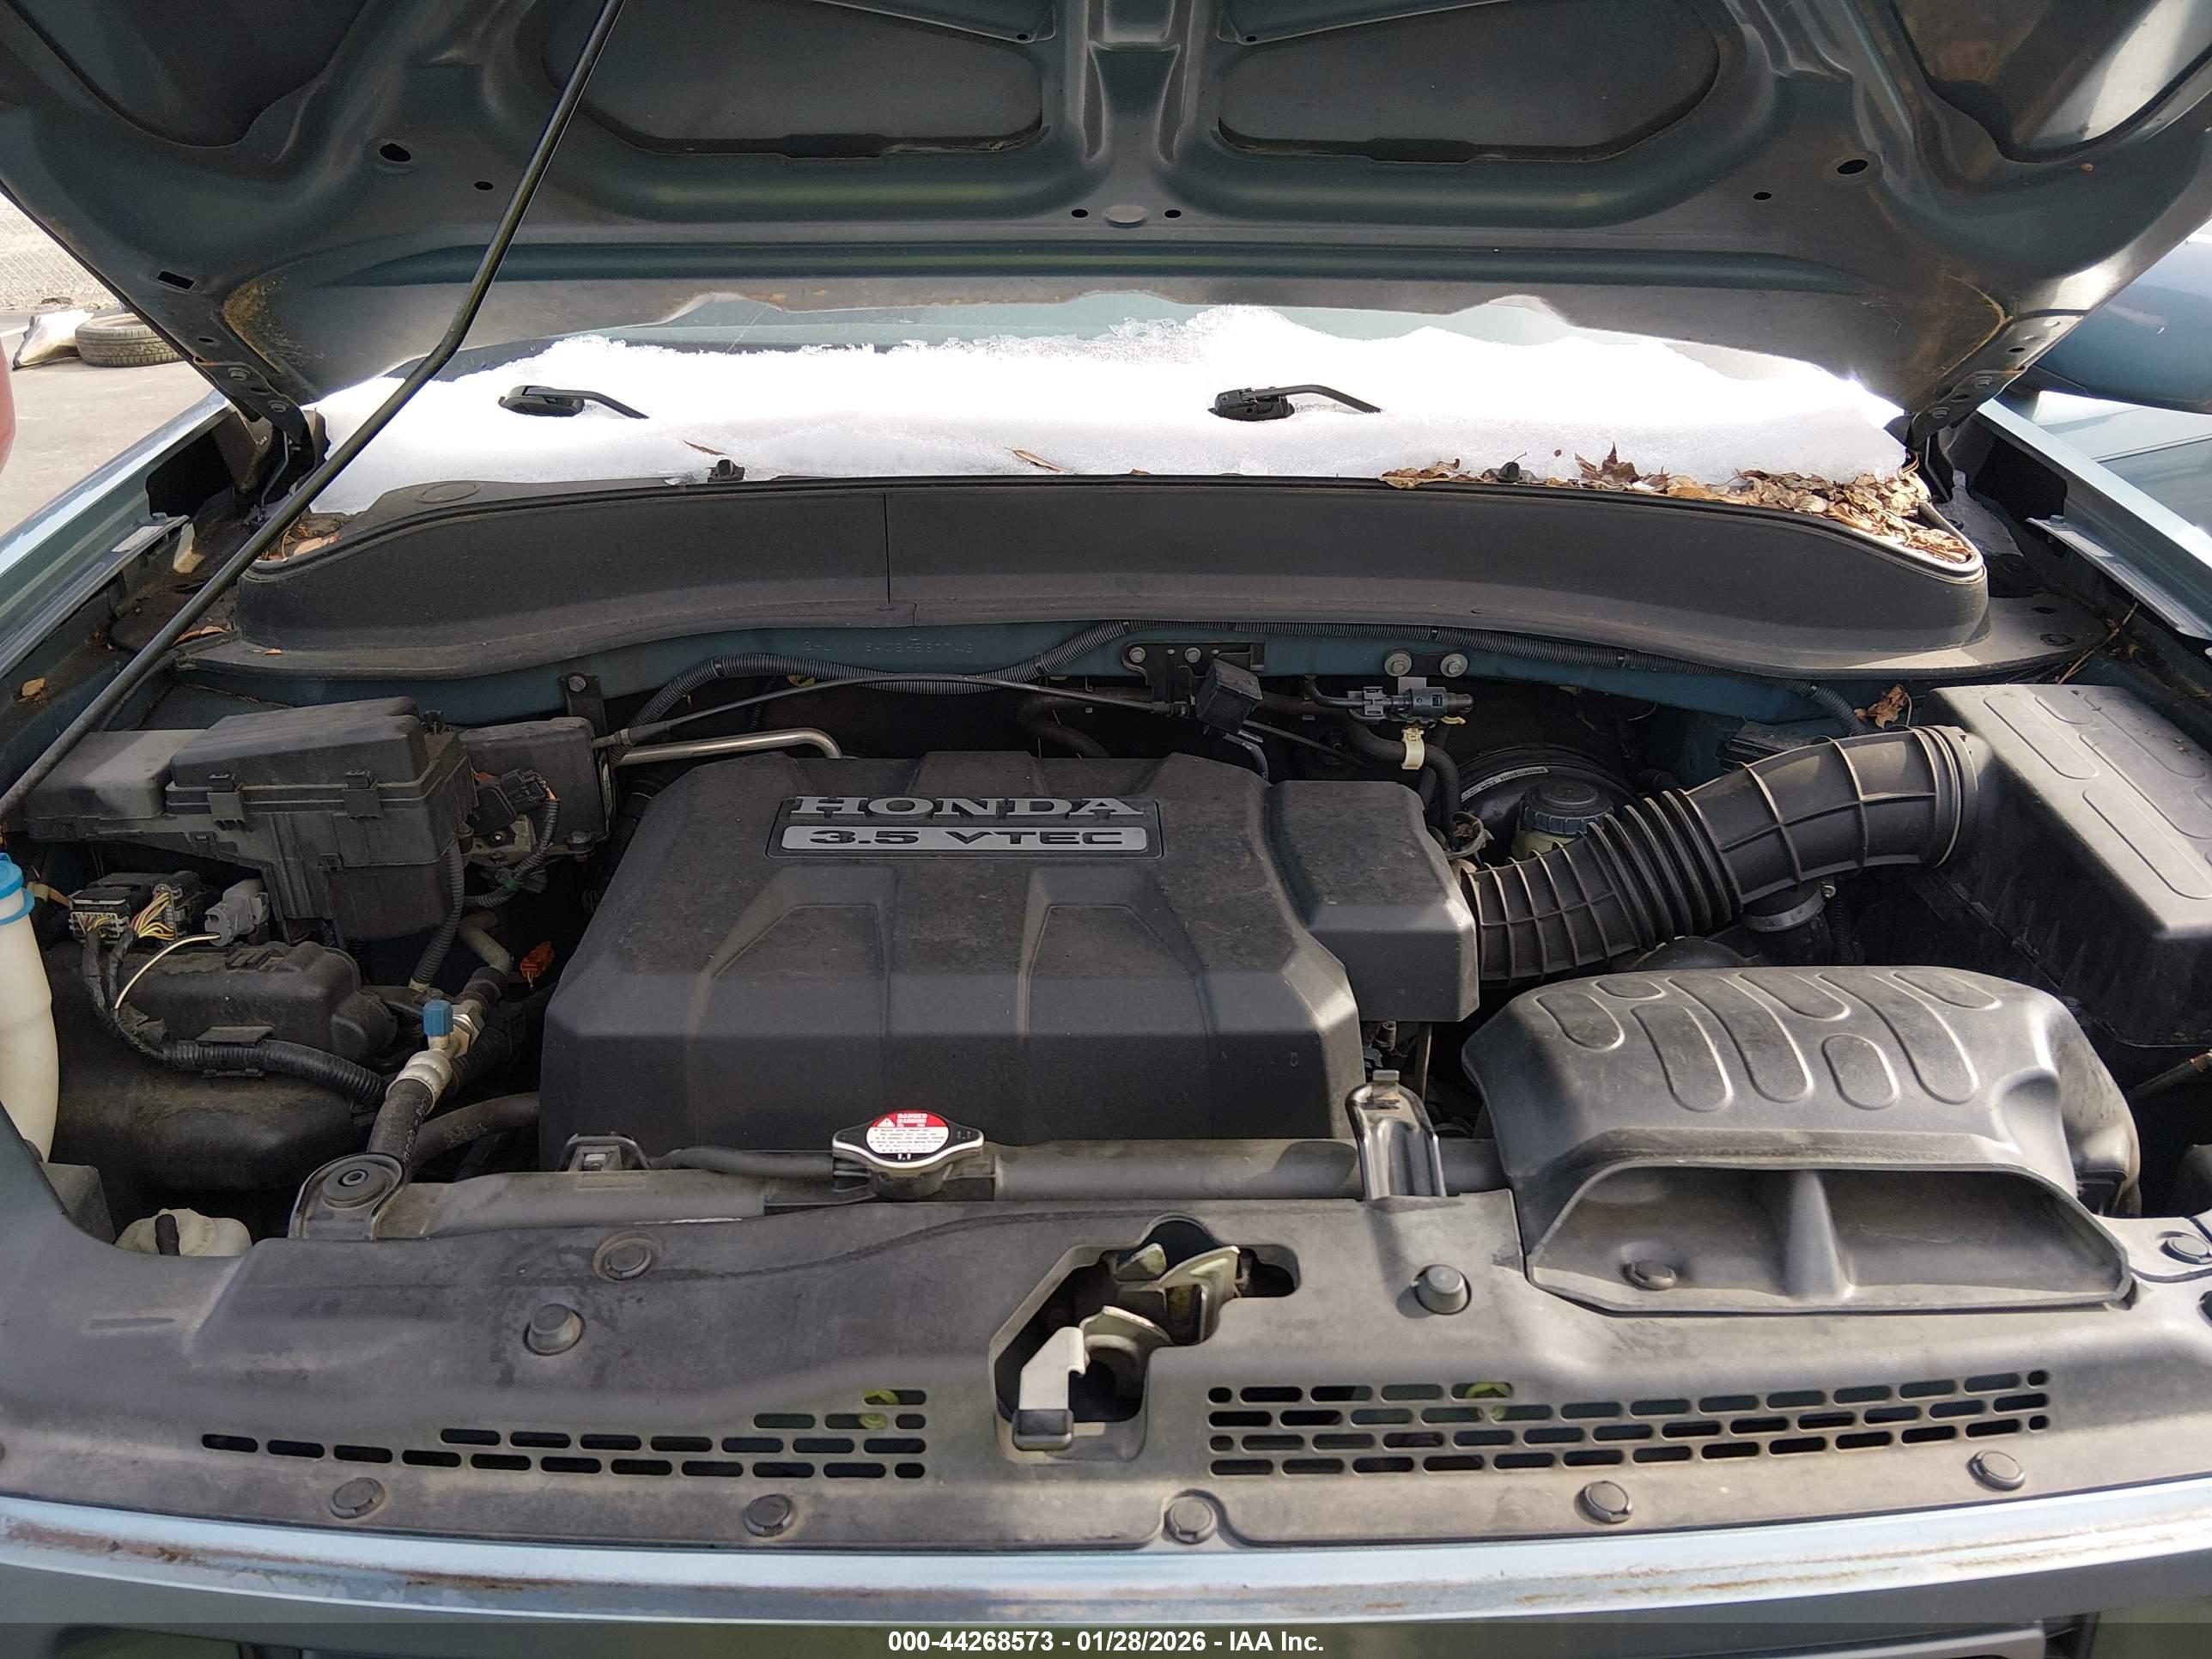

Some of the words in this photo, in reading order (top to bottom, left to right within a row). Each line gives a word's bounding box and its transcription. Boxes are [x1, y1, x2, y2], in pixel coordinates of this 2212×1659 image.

[790, 795, 1144, 817] HONDA
[810, 830, 920, 845] 3.5
[945, 830, 1123, 845] VTEC
